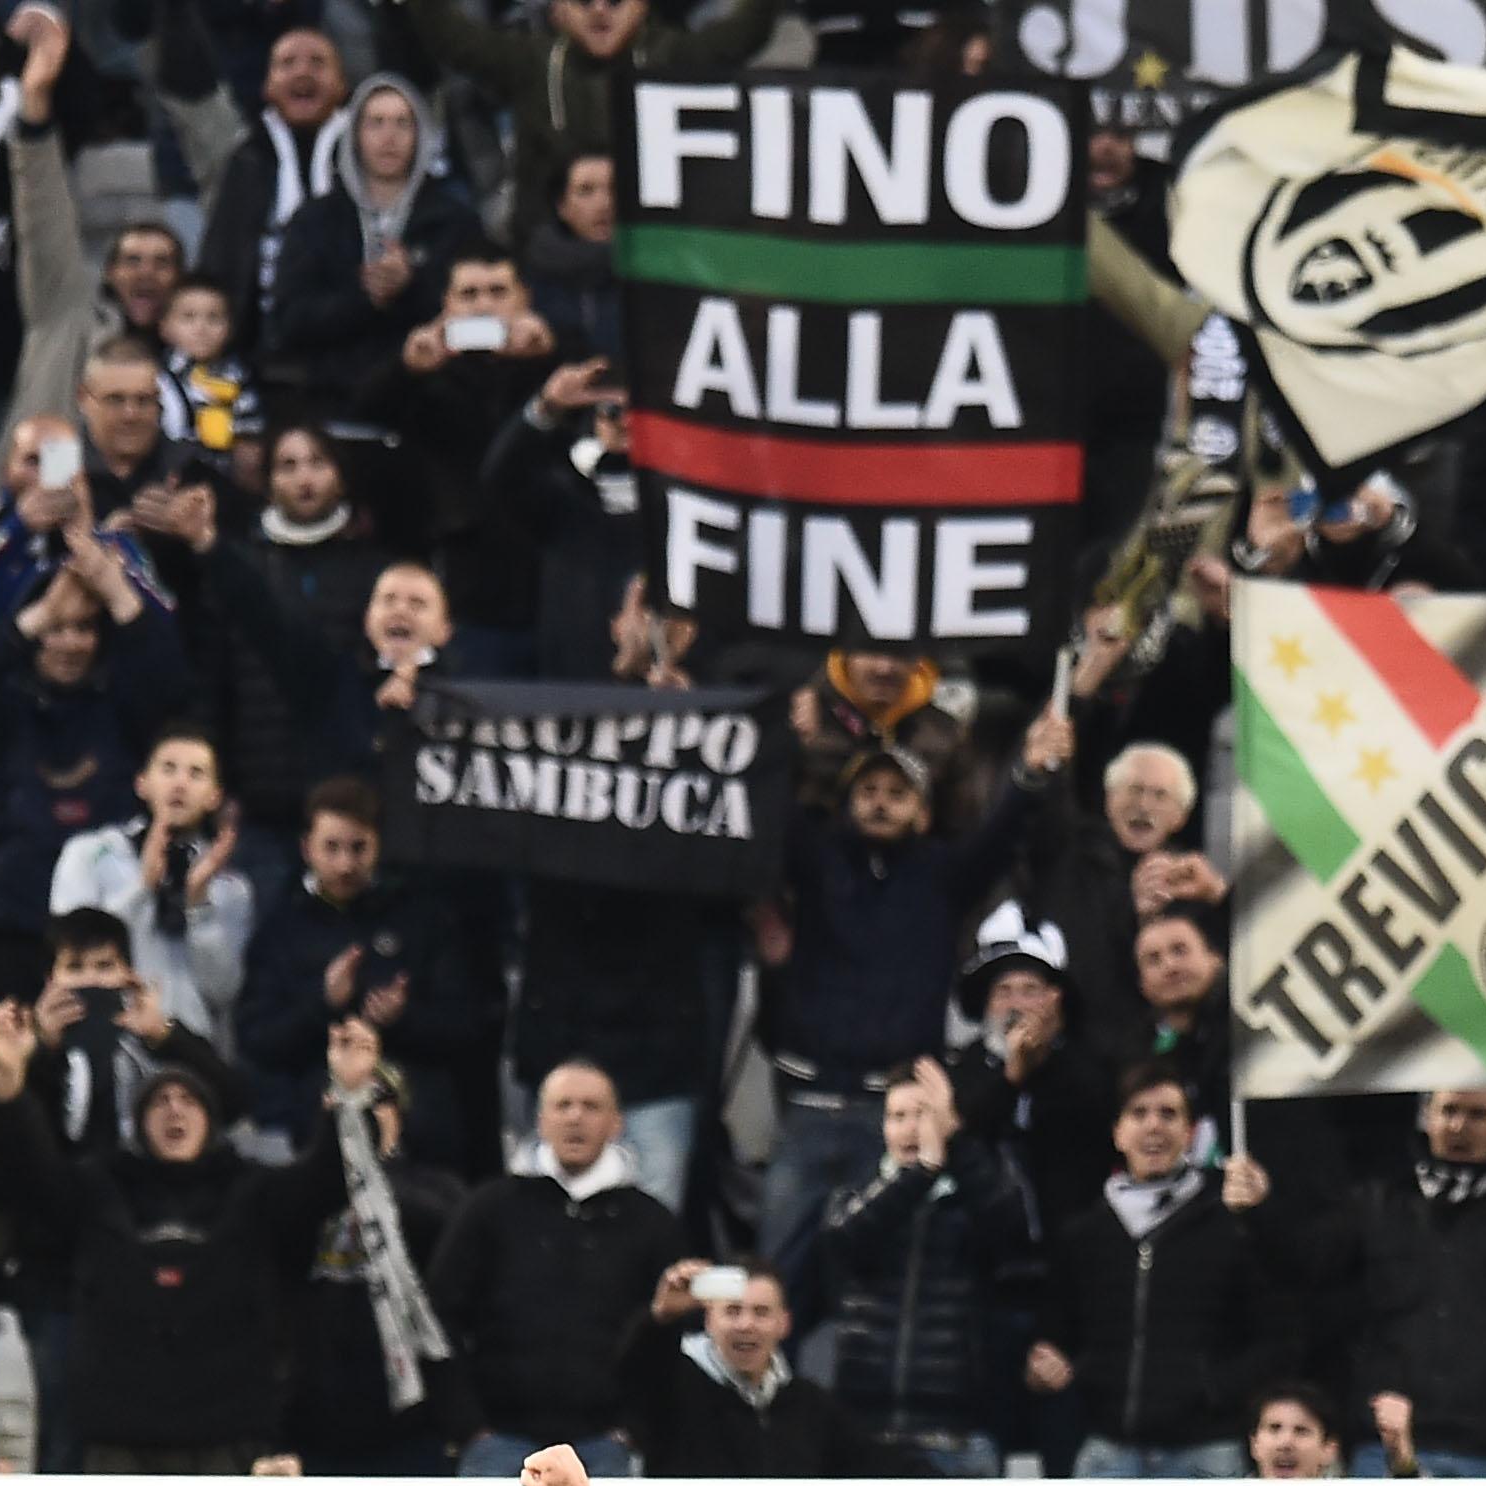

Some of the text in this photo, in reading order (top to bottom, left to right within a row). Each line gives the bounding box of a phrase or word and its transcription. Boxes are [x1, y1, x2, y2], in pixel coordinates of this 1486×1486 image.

[635, 83, 1071, 231] FINO
[673, 299, 1022, 430] ALLA
[667, 490, 1034, 640] FINE
[415, 744, 754, 840] SAMBUCA
